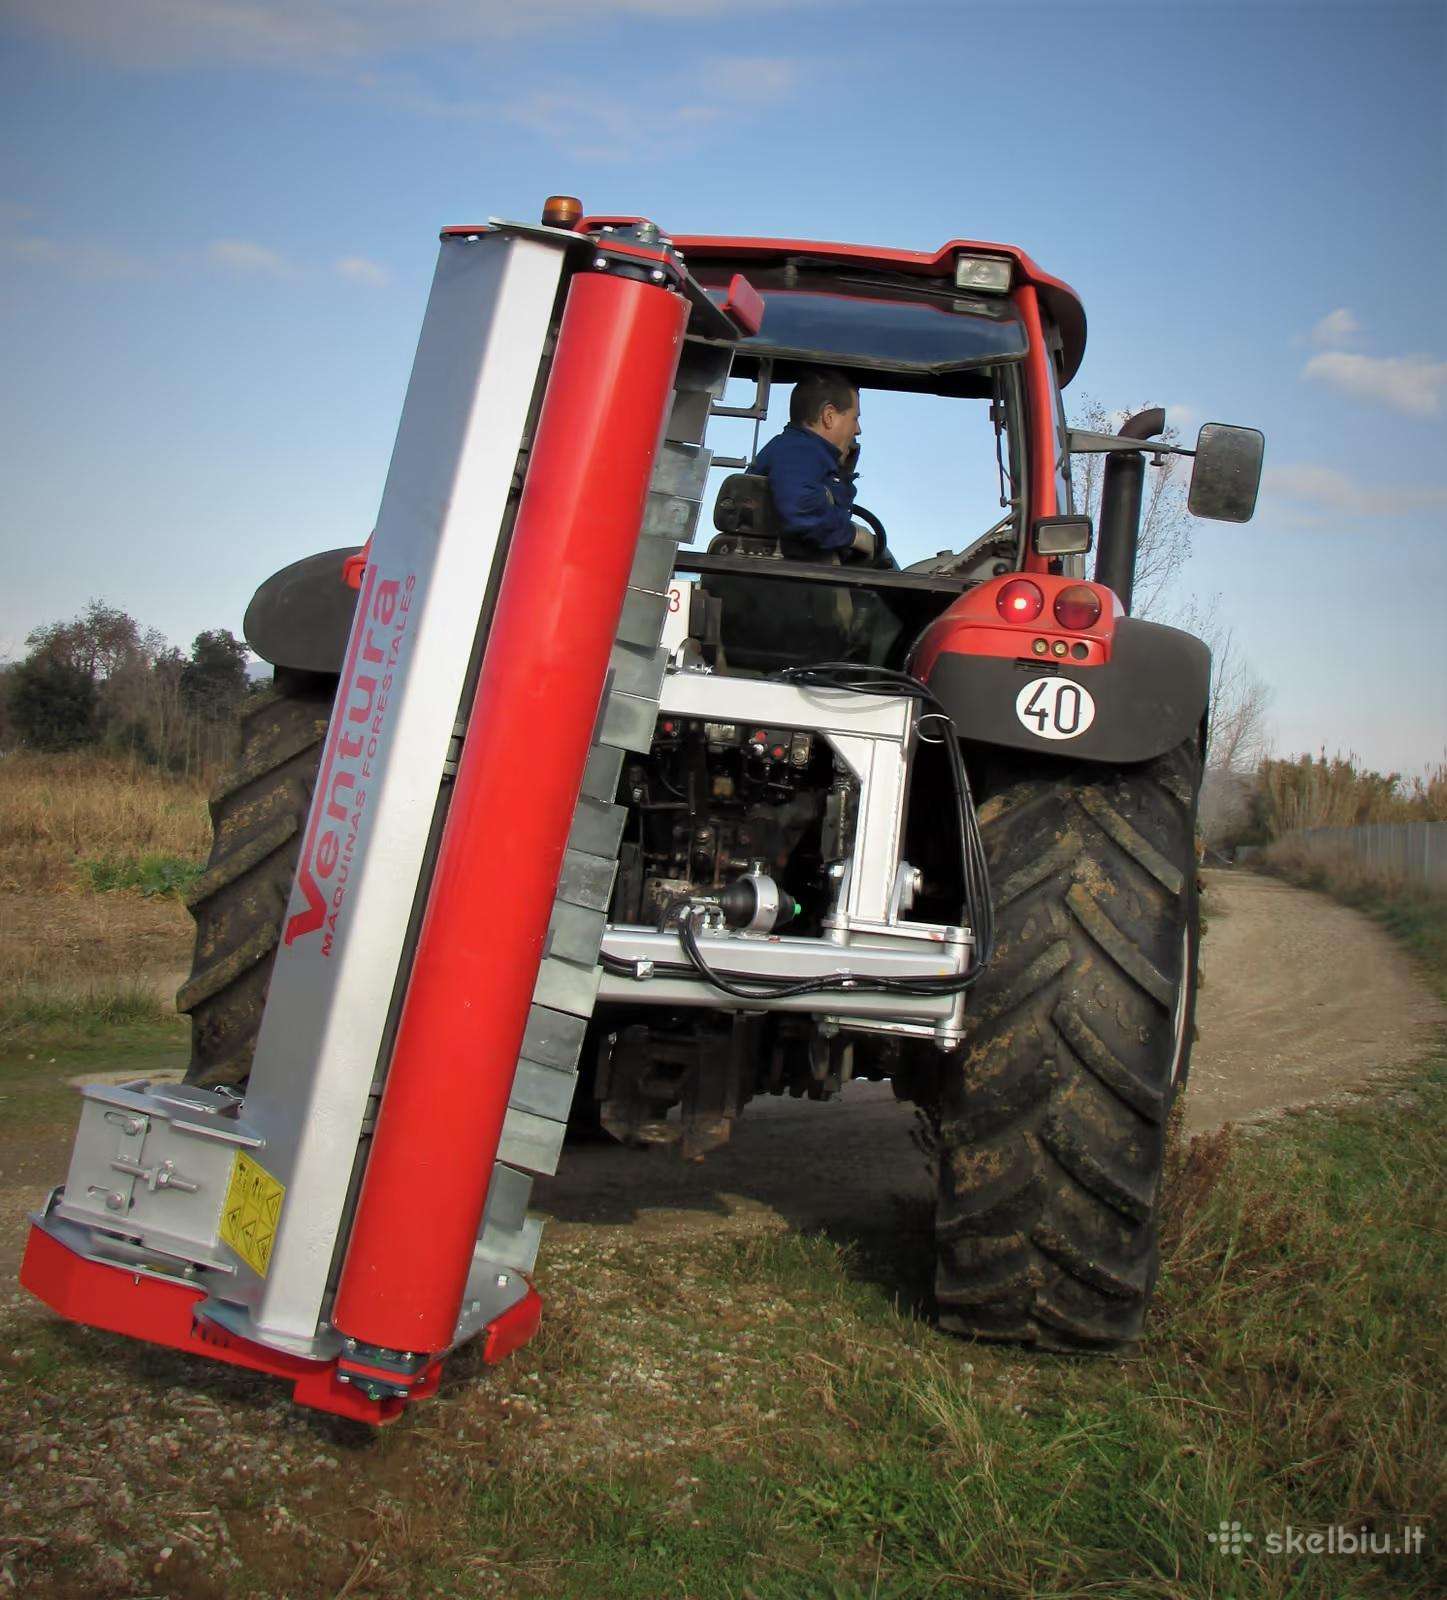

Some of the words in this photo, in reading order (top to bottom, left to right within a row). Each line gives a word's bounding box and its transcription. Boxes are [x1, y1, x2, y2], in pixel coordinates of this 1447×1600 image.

[285, 564, 400, 946] Ventura
[361, 574, 415, 778] FORESTALES
[1024, 682, 1081, 734] 40
